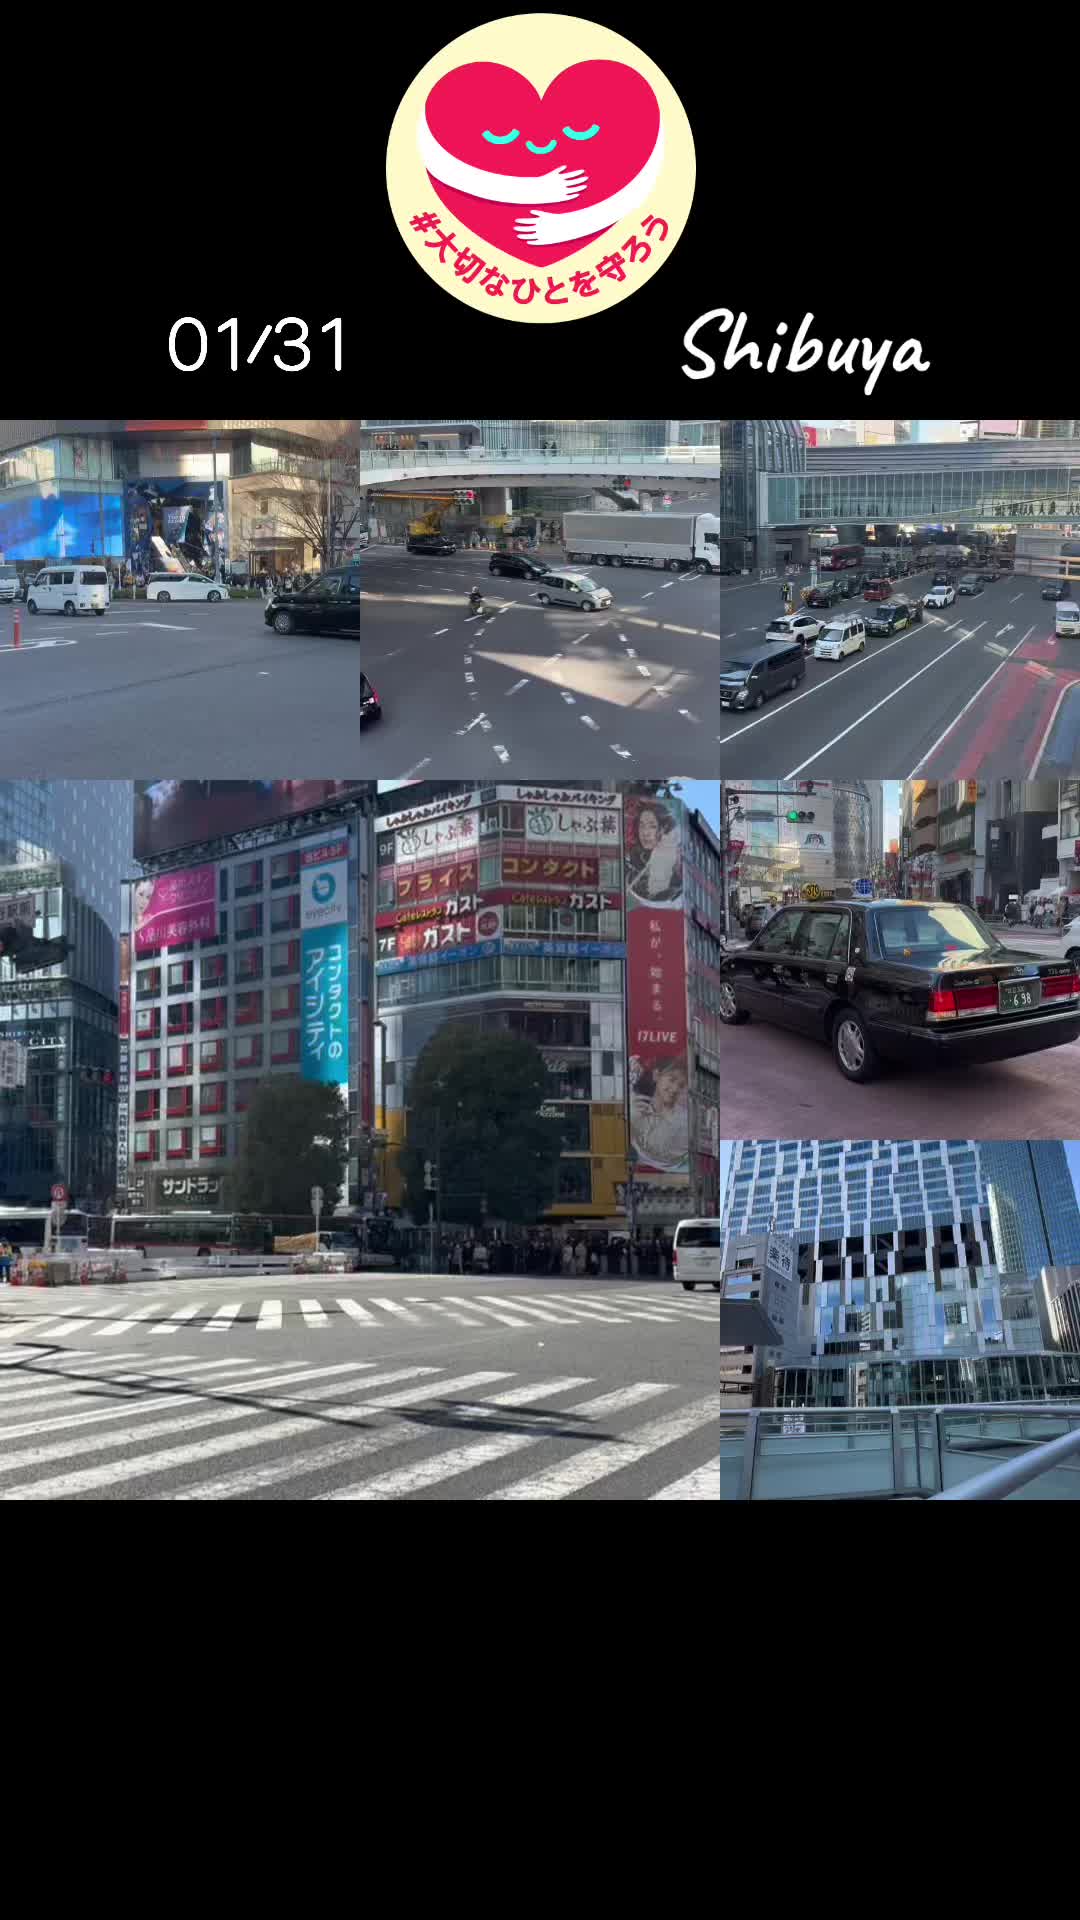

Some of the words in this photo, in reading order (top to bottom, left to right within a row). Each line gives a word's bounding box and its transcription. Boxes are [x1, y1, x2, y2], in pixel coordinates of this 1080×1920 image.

[557, 812, 617, 835] しゃぶ葉
[379, 842, 394, 857] 9F
[503, 857, 595, 879] コンタクト
[378, 936, 396, 952] 7F
[423, 922, 471, 950] ガスト
[304, 947, 325, 1061] アイシティ
[327, 944, 344, 1059] コンタクトの
[29, 1036, 66, 1046] CITY
